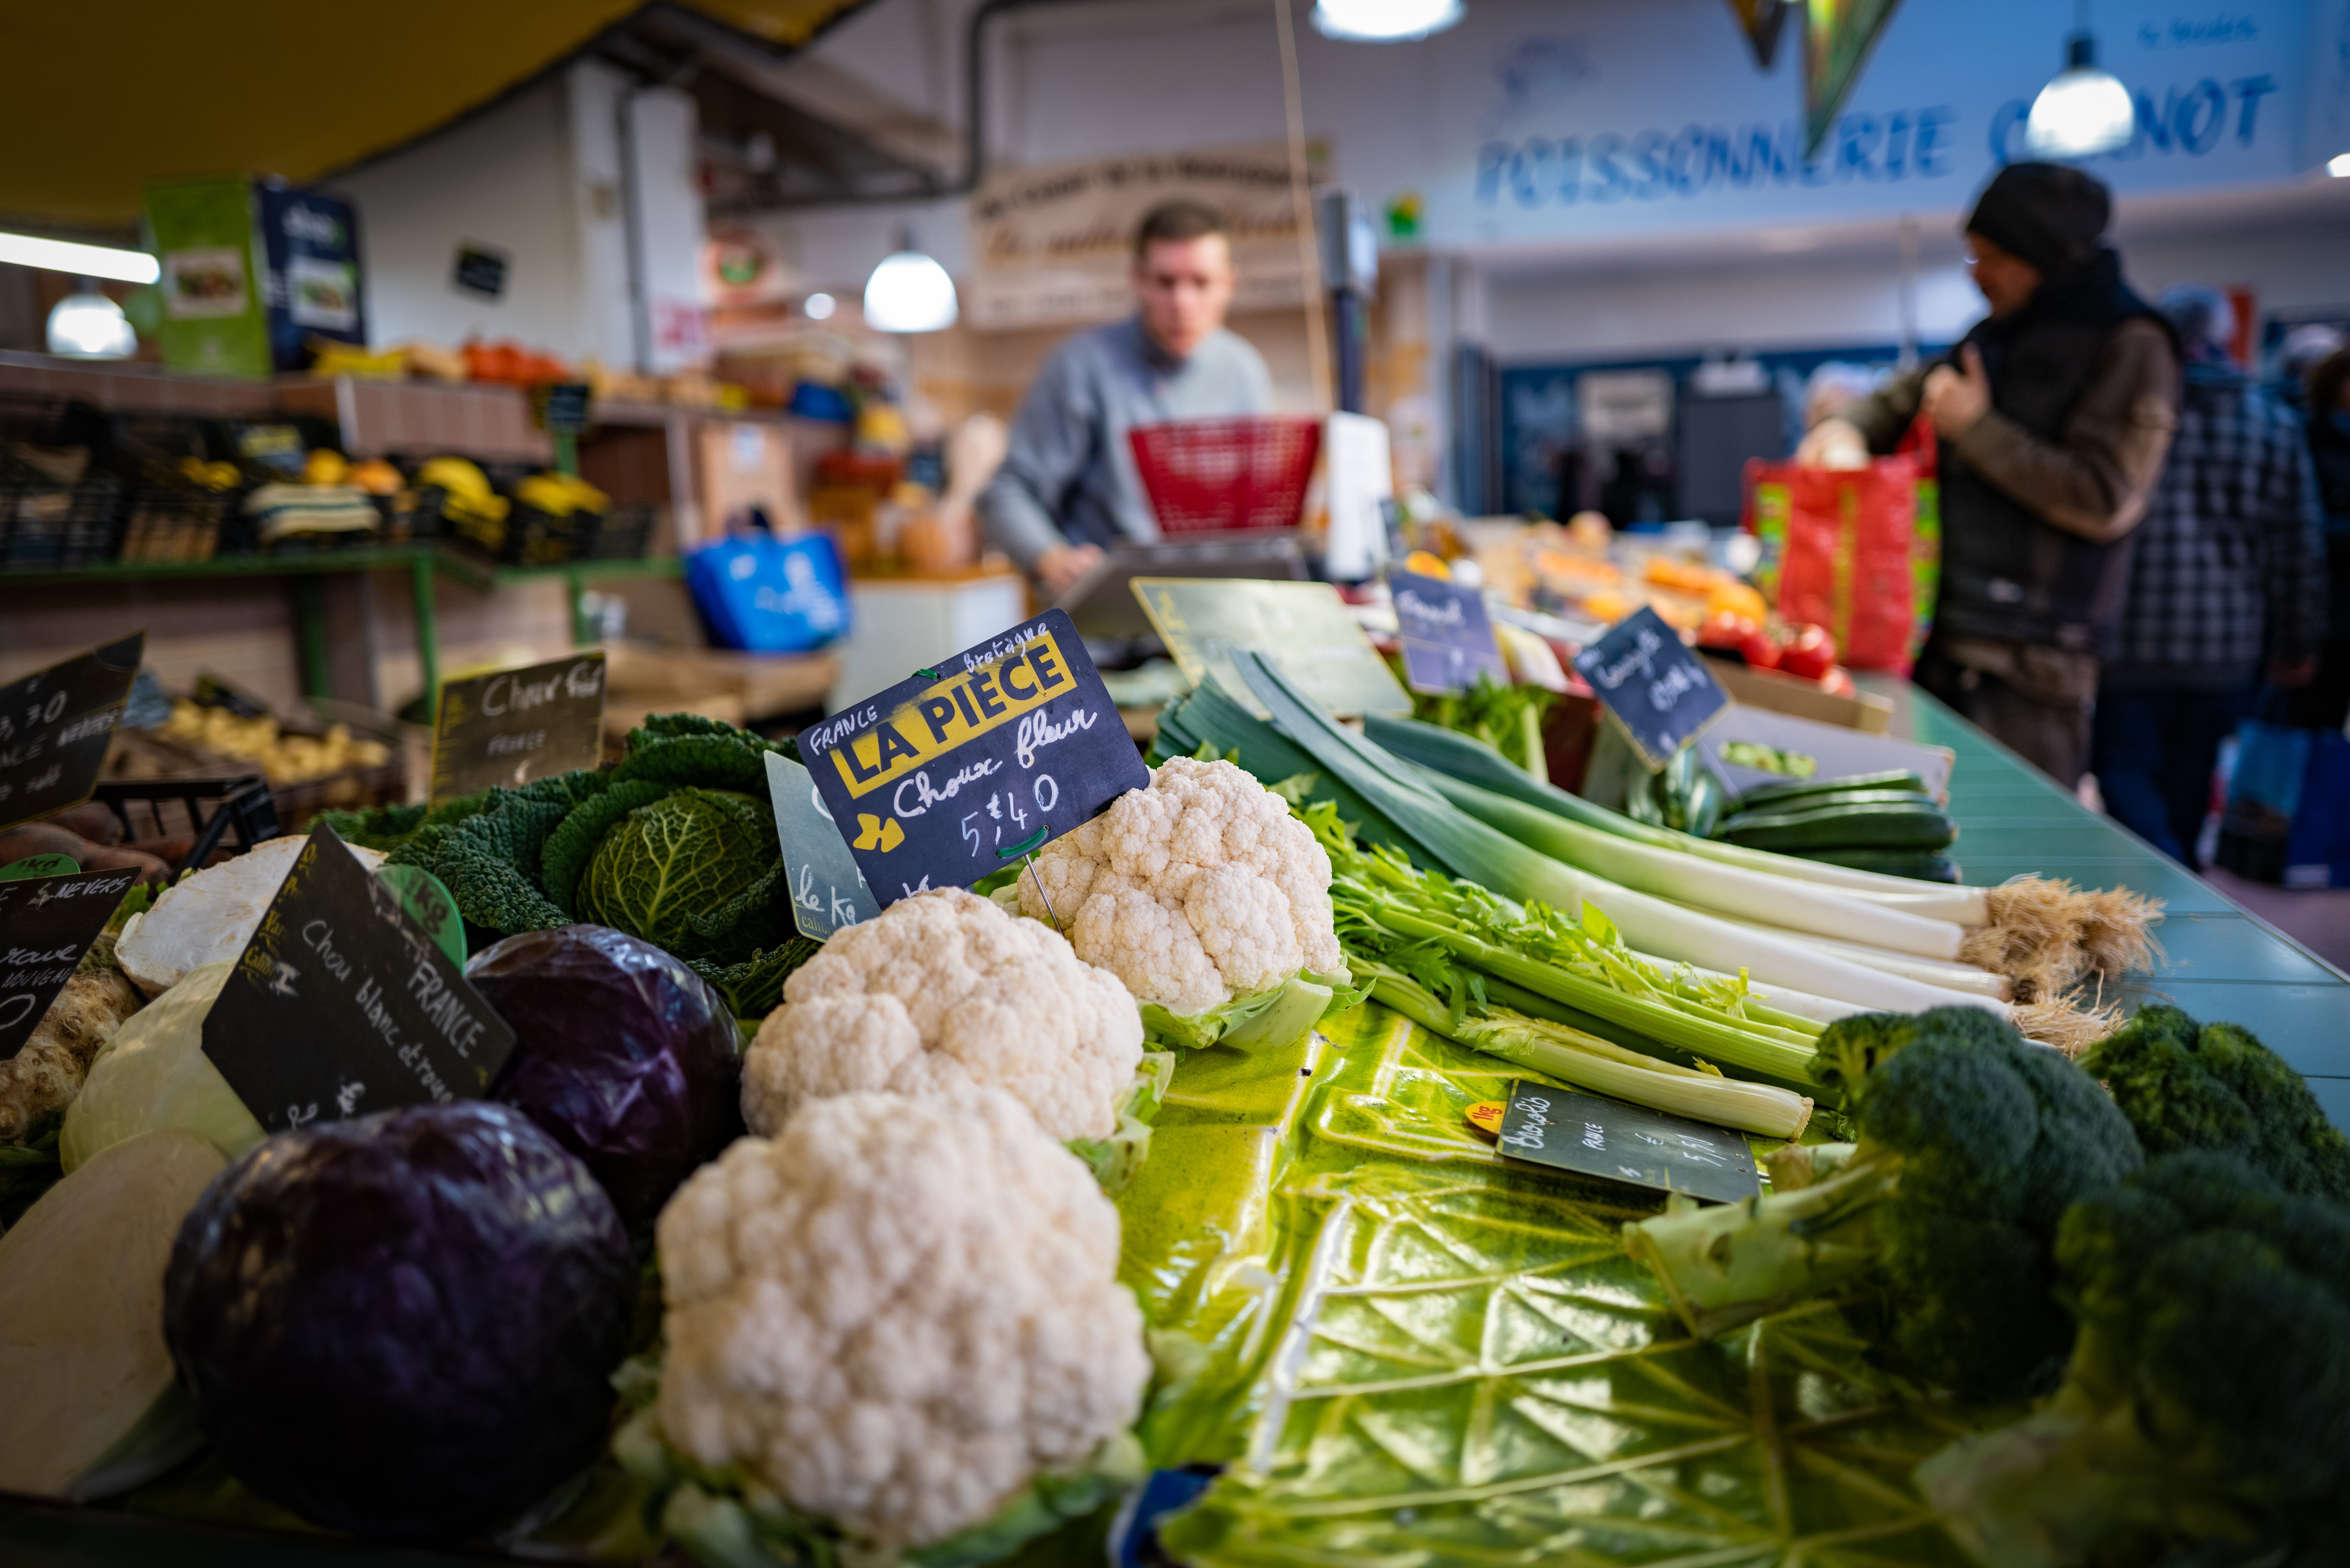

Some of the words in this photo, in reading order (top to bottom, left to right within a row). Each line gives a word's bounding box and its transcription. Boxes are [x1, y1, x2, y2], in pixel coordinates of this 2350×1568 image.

[1988, 73, 2278, 168] CNOT
[810, 706, 878, 756] FRANCE
[836, 722, 920, 784] LA
[919, 643, 1064, 744] PIÈCE
[1015, 708, 1097, 769] fleur
[303, 919, 352, 983] Chou
[356, 978, 400, 1046] blanc
[414, 1057, 454, 1104] rou
[407, 960, 486, 1059] FRANCE
[1471, 1106, 1503, 1121] 1kg
[1582, 1122, 1607, 1151] FRANCE
